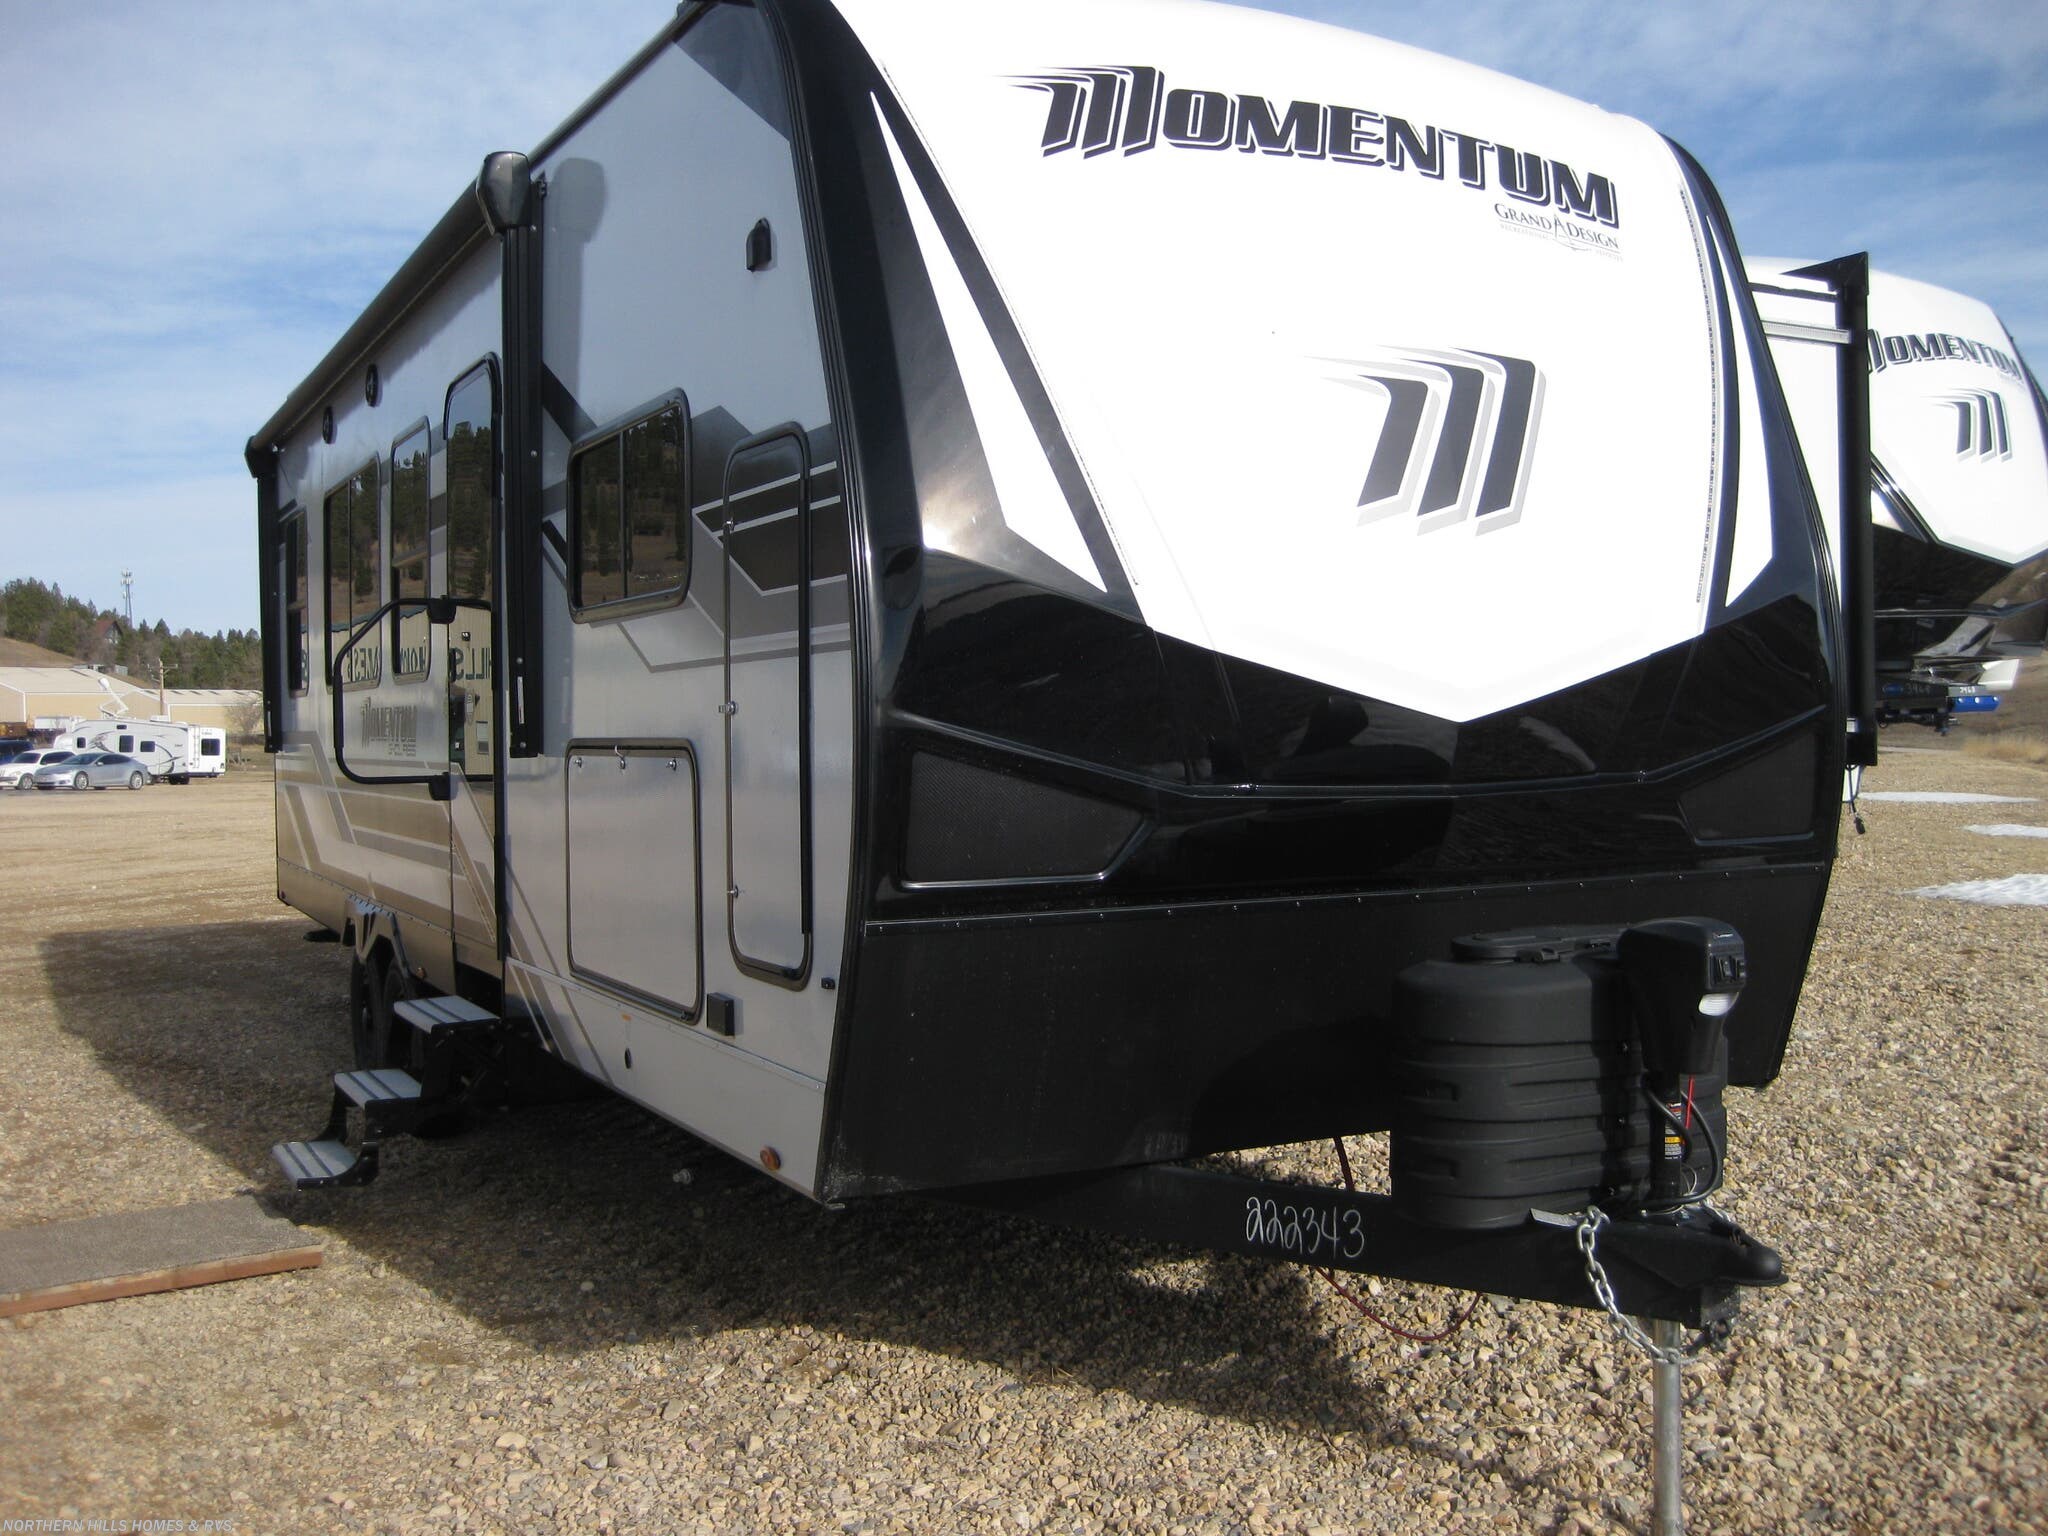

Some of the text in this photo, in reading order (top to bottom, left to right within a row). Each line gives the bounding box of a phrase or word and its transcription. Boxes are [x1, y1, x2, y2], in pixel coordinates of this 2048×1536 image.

[1001, 65, 1619, 229] MOMENTUM
[1494, 203, 1619, 249] GRAND DESIGN
[1246, 1196, 1365, 1258] 222343
